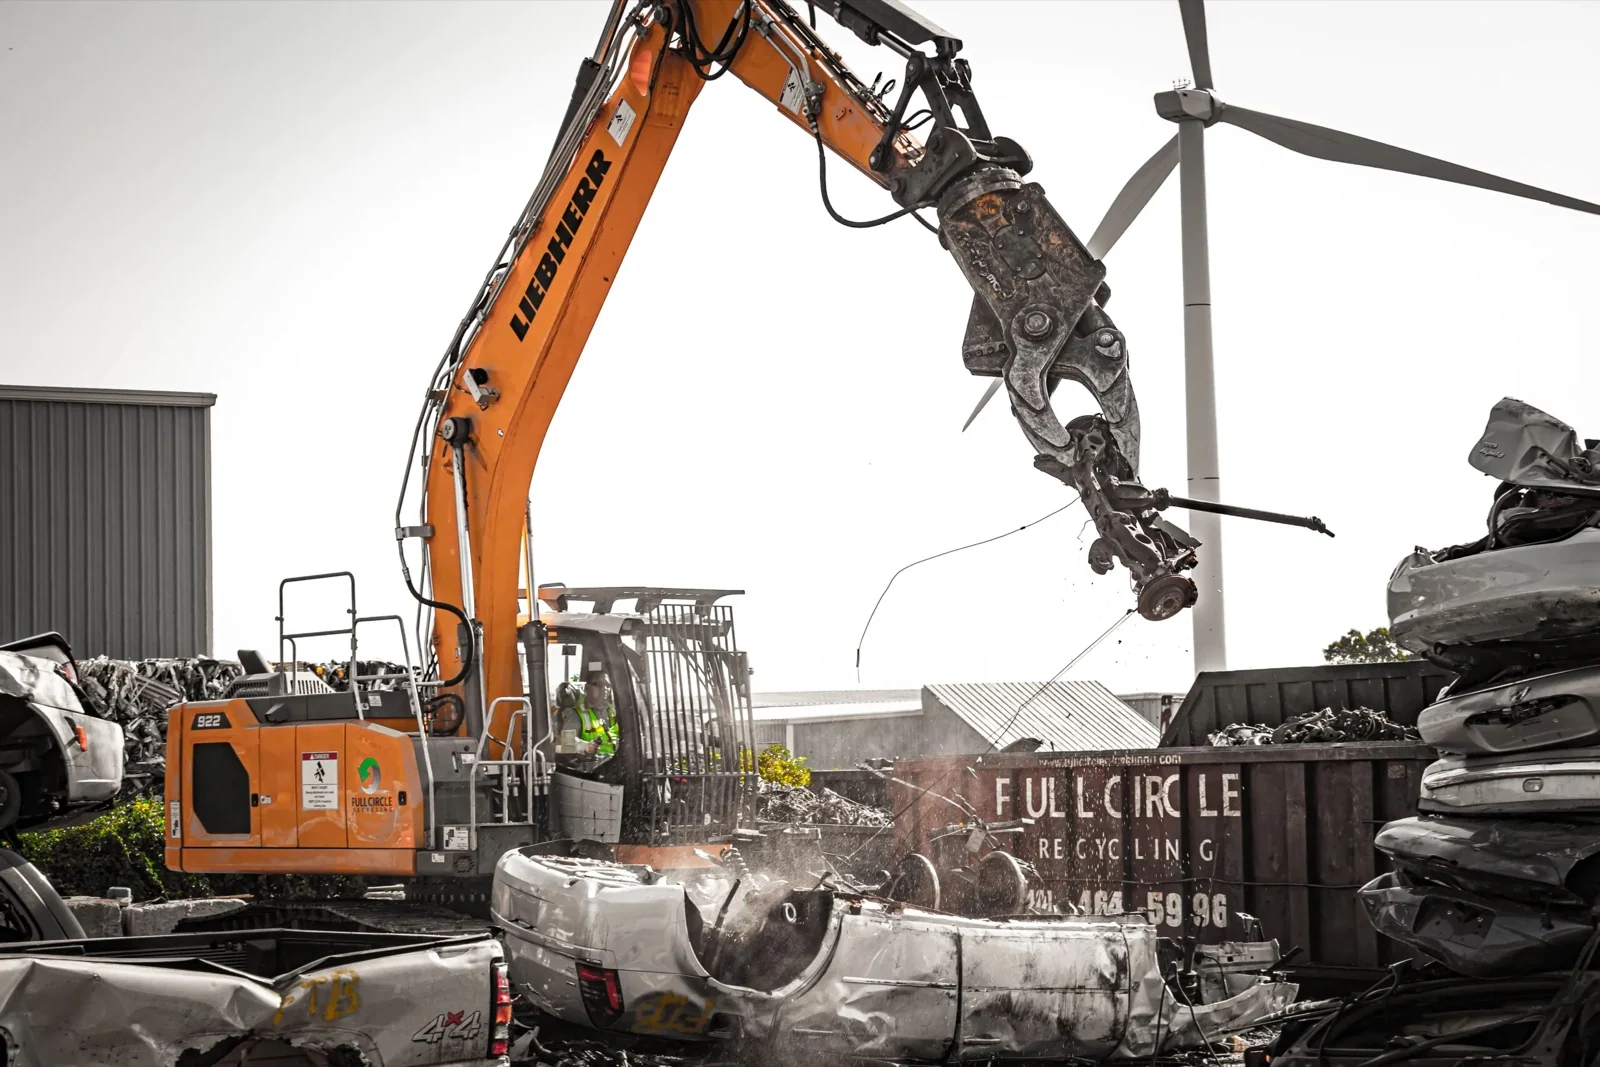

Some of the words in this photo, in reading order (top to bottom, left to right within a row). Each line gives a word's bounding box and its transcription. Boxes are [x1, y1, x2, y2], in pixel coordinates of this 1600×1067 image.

[508, 148, 613, 342] LIEBHERR
[197, 714, 221, 728] 922
[351, 797, 367, 807] FULL
[367, 796, 393, 807] CIRCLE
[995, 775, 1094, 819] FULL
[1103, 773, 1242, 819] CIRCLE
[1038, 837, 1214, 862] RECYCLING
